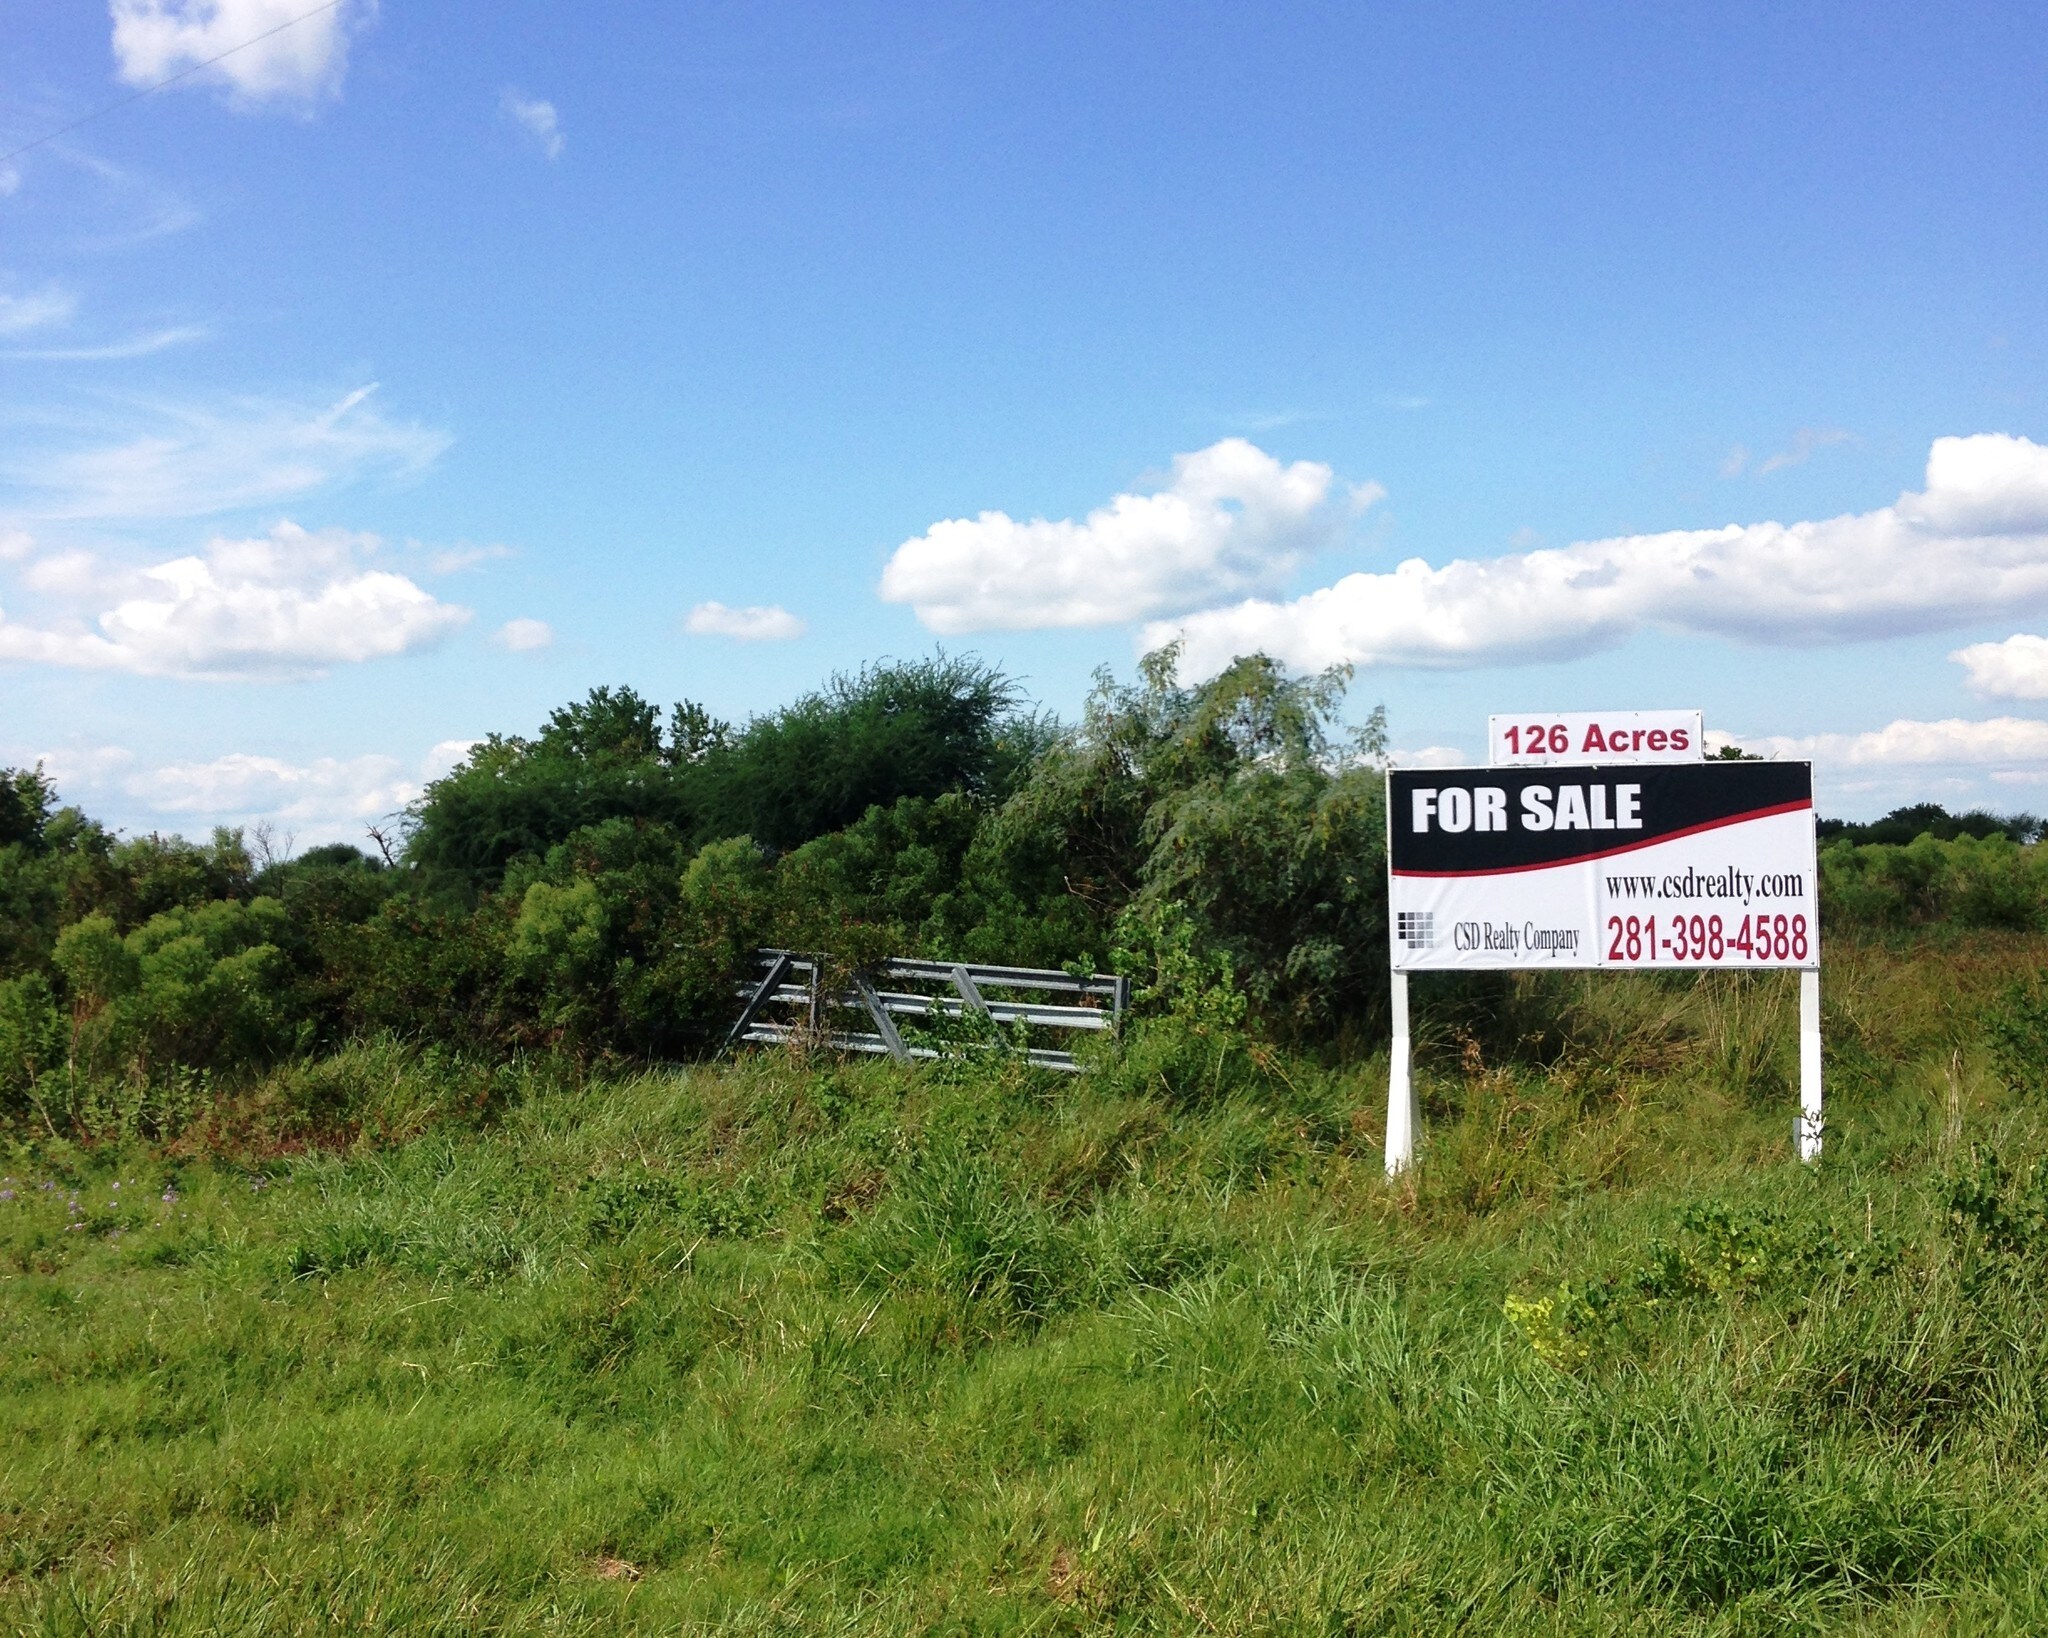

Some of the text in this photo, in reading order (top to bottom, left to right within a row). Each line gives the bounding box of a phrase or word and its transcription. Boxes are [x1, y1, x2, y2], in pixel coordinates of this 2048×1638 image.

[1504, 723, 1690, 755] 126 Acres
[1411, 783, 1643, 833] FOR SALE
[1606, 865, 1804, 906] www.csdrealty.com
[1454, 921, 1580, 958] CSD Realty Company
[1607, 914, 1809, 961] 281-398-4588
